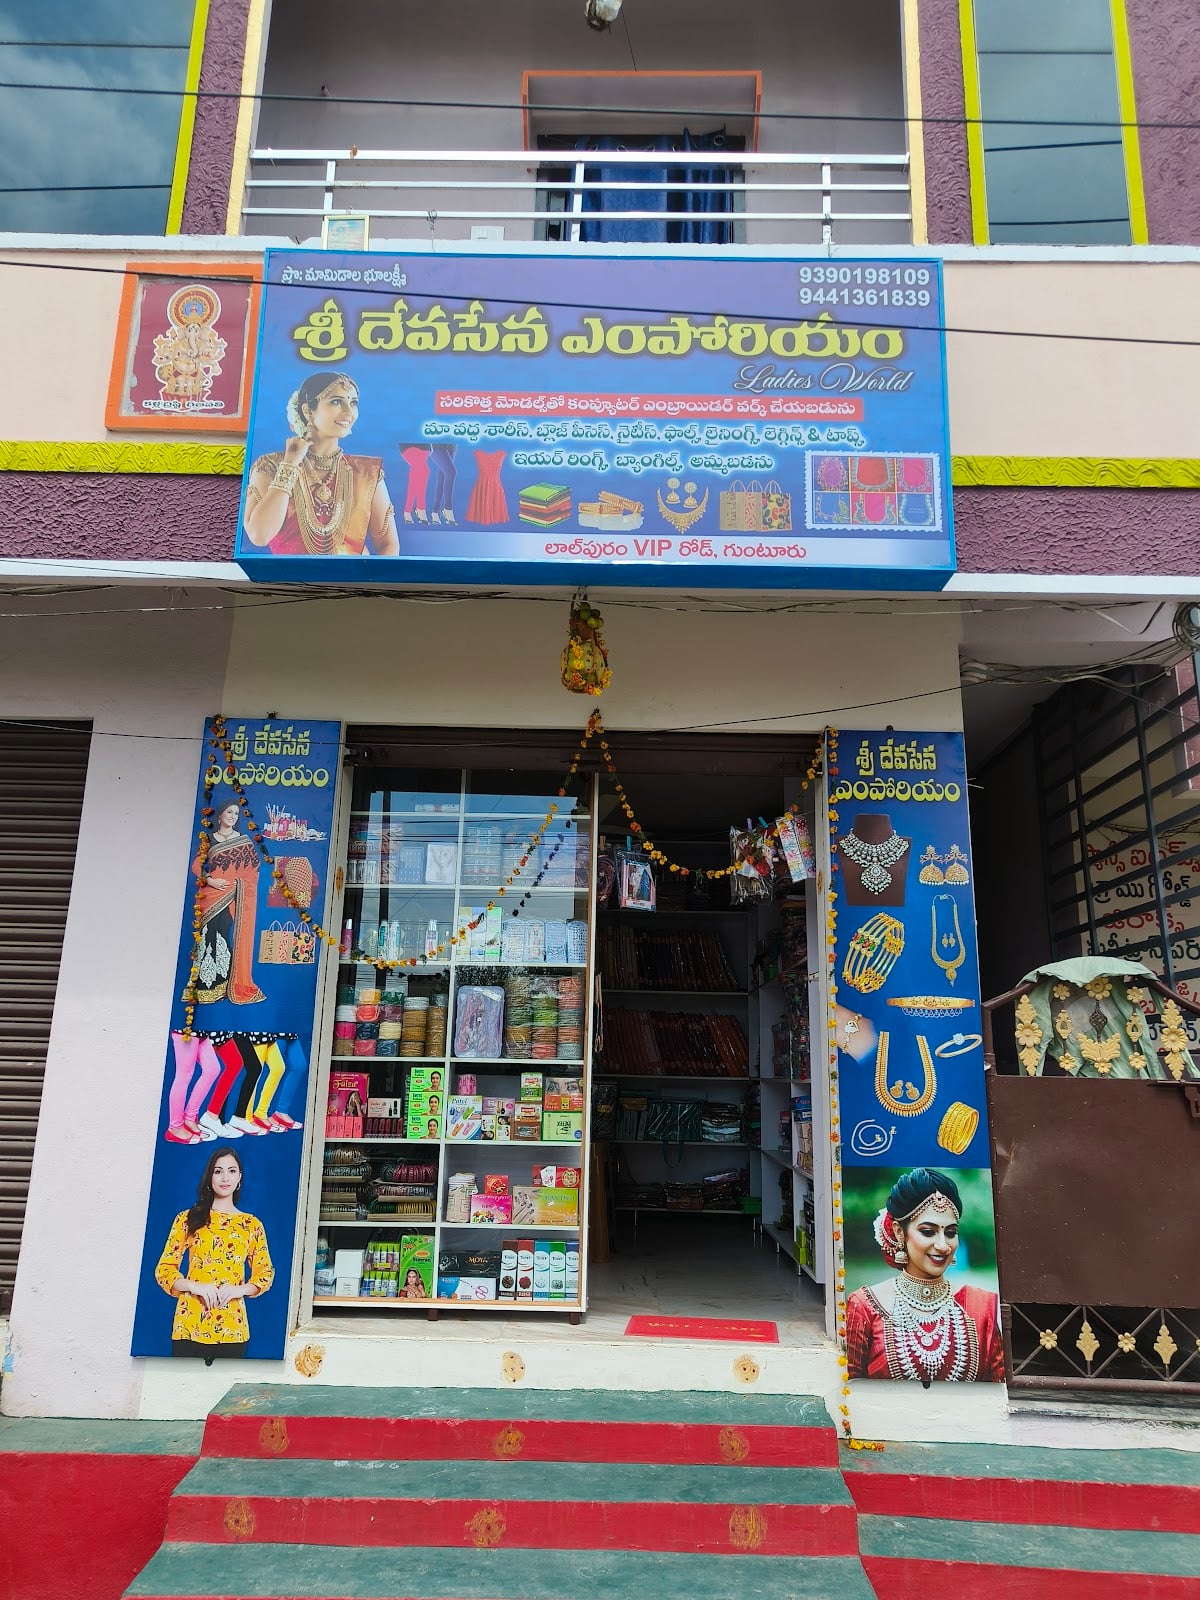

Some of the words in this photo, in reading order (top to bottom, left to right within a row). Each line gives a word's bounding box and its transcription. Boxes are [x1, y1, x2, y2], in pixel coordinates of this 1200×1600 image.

[304, 267, 362, 282] మామిడాల
[799, 266, 931, 286] 9390198109
[799, 287, 931, 307] 9441361839
[293, 298, 348, 362] శ్రీ
[357, 298, 550, 354] దేవసేన
[561, 311, 904, 360] ఎంపోరియం
[733, 363, 813, 393] Ladies
[818, 362, 914, 393] World
[439, 395, 493, 413] సరికొత్త
[567, 396, 641, 416] కంప్యూటర్
[642, 398, 734, 416] ఎంబ్రాయిడర్
[736, 398, 769, 417] వర్క్
[769, 398, 856, 416] చేయబడును
[424, 423, 451, 437] మా
[453, 423, 481, 441] వద్ద
[807, 427, 821, 442] &
[513, 450, 565, 466] ఇయర్
[633, 538, 673, 557] VIP
[678, 539, 719, 559] రోడ్,
[723, 543, 807, 559] గుంటూరు
[229, 724, 249, 761] శ్రీ
[253, 723, 311, 756] దేవసేన
[855, 739, 875, 776] శ్రీ
[878, 738, 937, 771] దేవసేన
[835, 777, 961, 802] ఎంపోరియం
